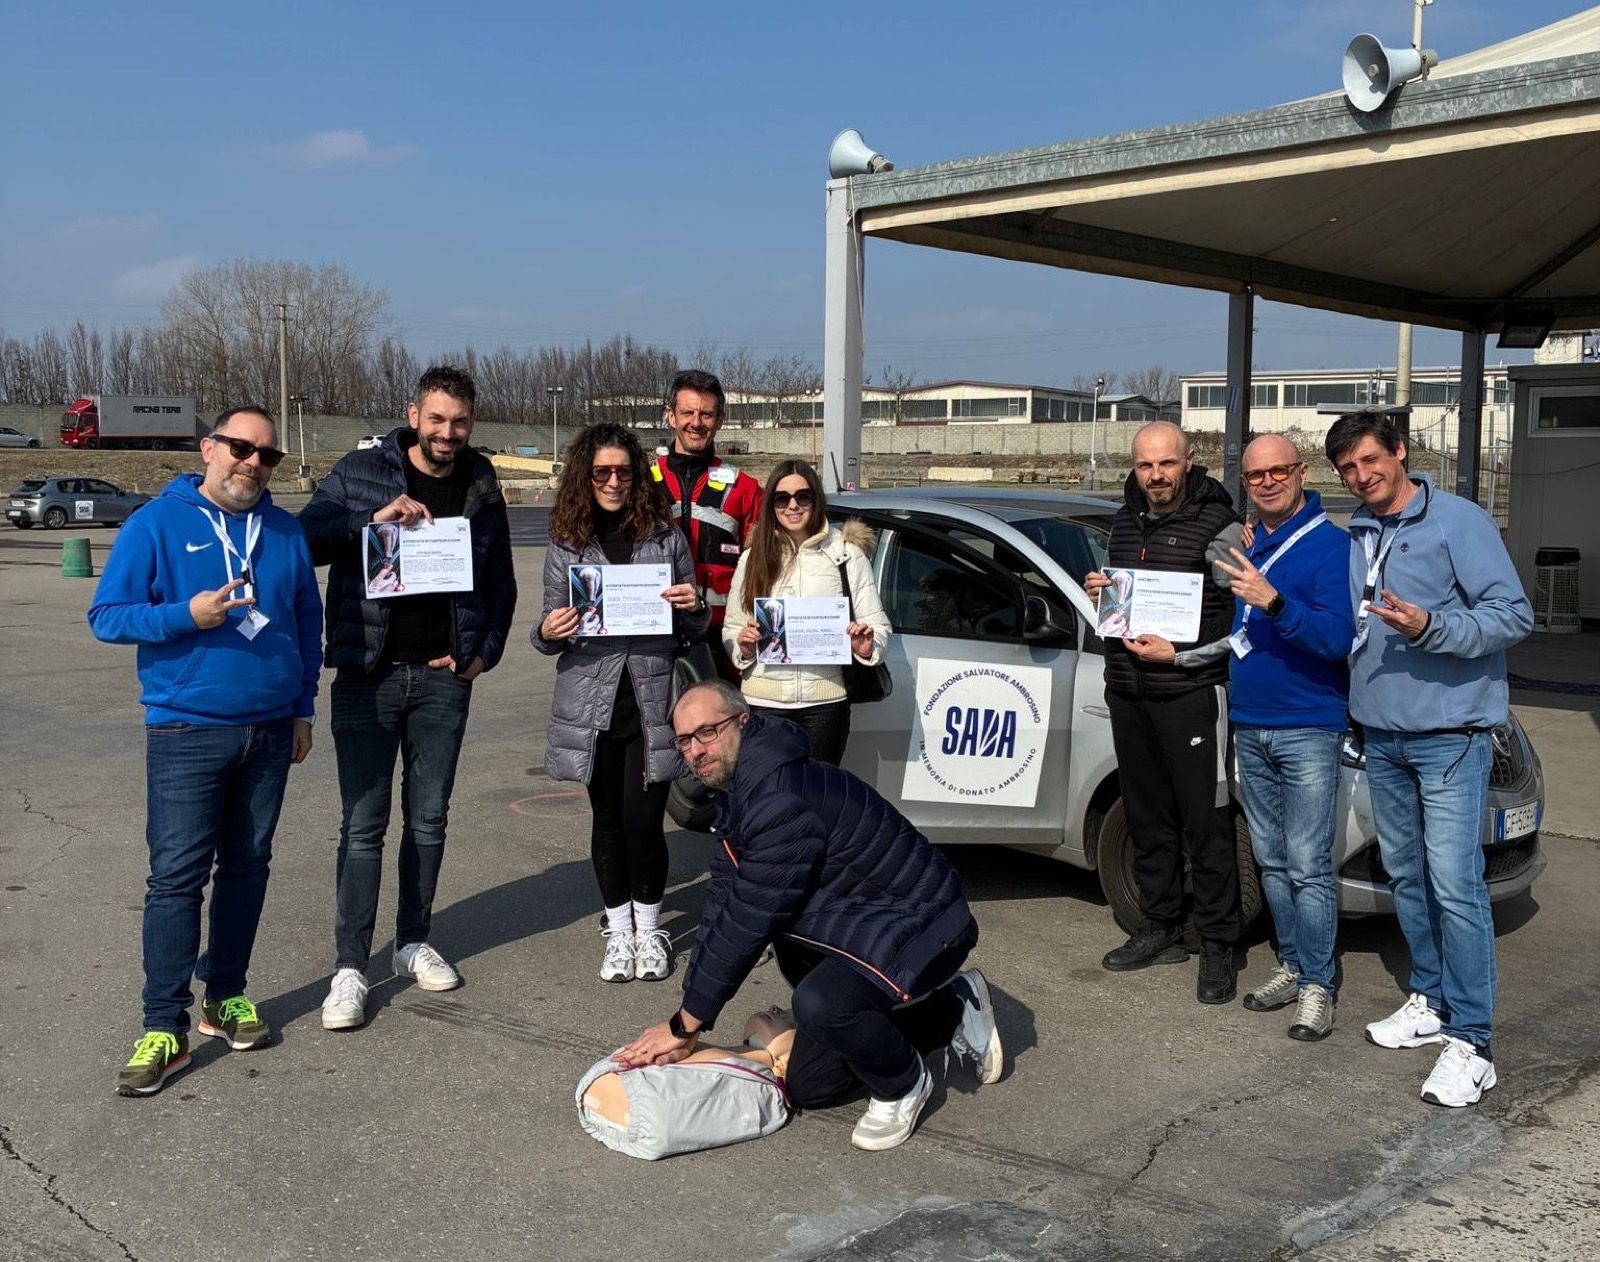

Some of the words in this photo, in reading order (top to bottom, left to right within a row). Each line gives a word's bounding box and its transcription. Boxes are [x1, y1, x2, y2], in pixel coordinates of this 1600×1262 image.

[133, 405, 160, 414] RACING
[161, 406, 182, 414] TEAM
[923, 672, 963, 716] FONDAZIONE
[963, 668, 1010, 682] SALVATORE
[1010, 679, 1041, 724] AMBROSINO
[919, 740, 926, 750] IN
[920, 752, 946, 786] MEMORIA
[998, 748, 1037, 790] AMBROSINO
[959, 786, 996, 796] DONATO
